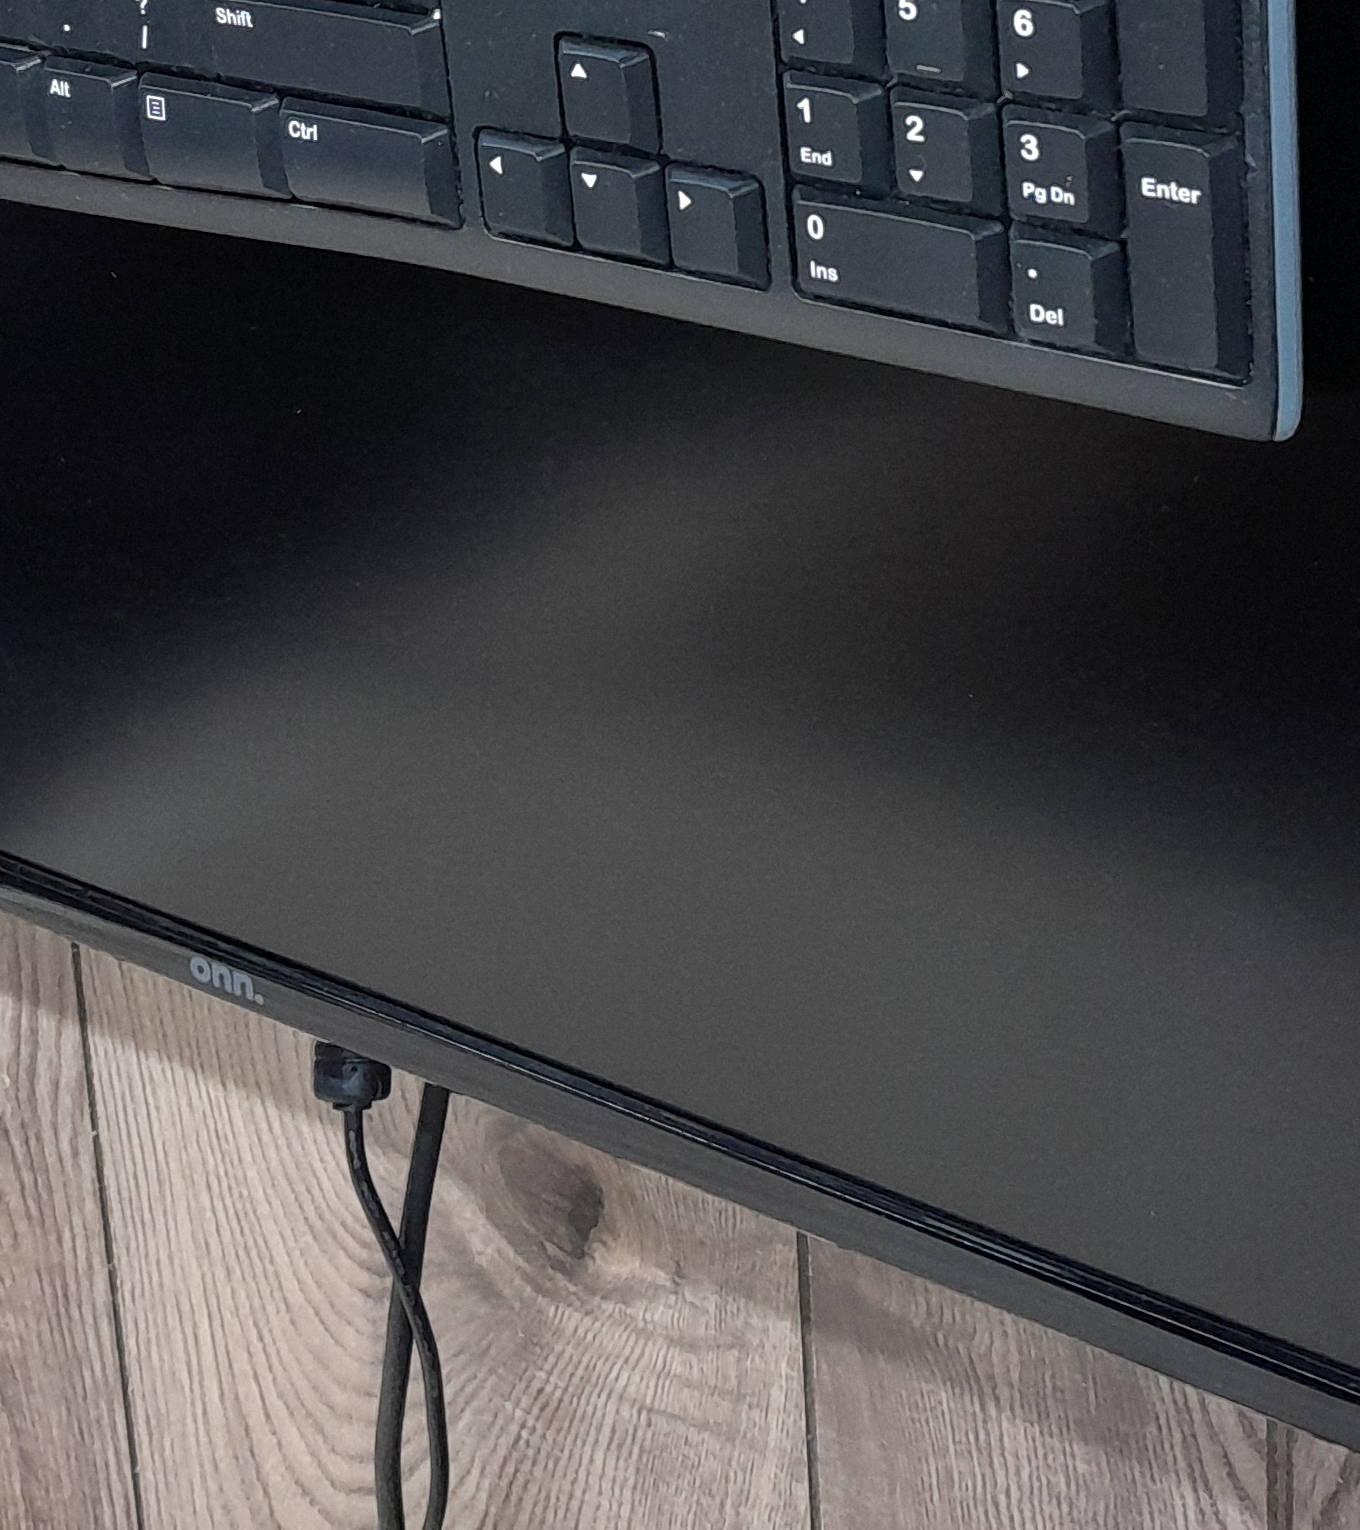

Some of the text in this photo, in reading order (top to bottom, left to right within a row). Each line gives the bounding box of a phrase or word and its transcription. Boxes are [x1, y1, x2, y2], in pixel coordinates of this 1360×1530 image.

[215, 7, 254, 28] Shift
[1013, 9, 1034, 37] 6
[49, 78, 71, 98] Alt
[796, 97, 811, 123] 1
[288, 120, 318, 141] Ctrl
[905, 115, 925, 142] 2
[800, 146, 833, 167] End
[1020, 133, 1040, 161] 3
[1022, 181, 1075, 206] Pg Dn
[1141, 177, 1202, 205] Enter
[807, 214, 824, 240] 0
[810, 260, 839, 282] Ins
[1029, 303, 1064, 326] Del
[190, 955, 266, 1007] onn.
